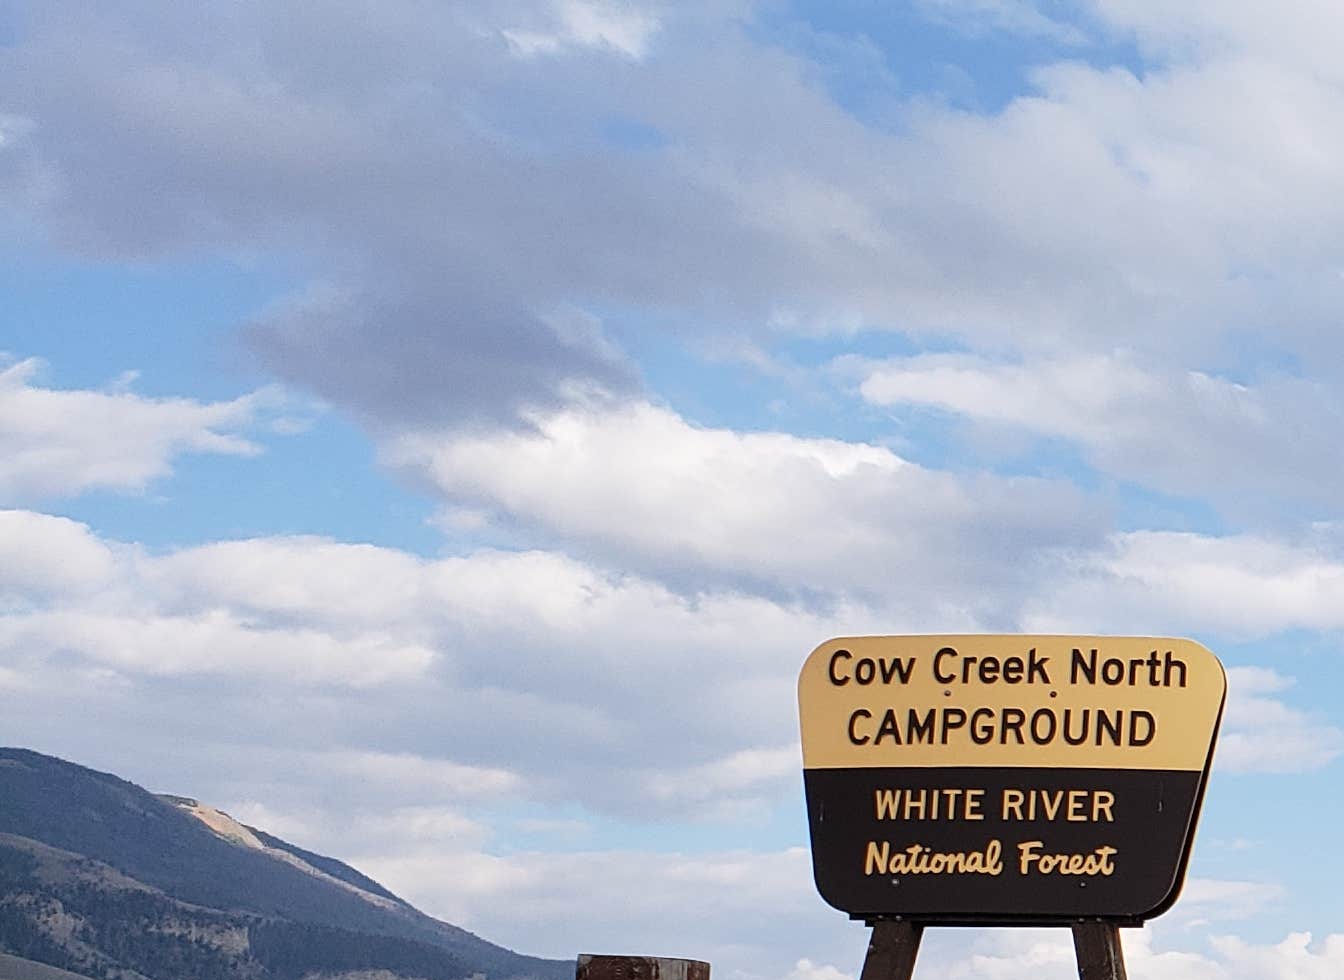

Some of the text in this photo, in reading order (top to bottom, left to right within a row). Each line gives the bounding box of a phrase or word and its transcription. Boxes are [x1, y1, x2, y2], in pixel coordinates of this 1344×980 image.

[828, 647, 1187, 687] Cow Creek North
[848, 708, 1157, 747] CAMPGROUND
[875, 789, 1115, 822] WHITE RIVER
[864, 840, 1118, 875] National Forest
